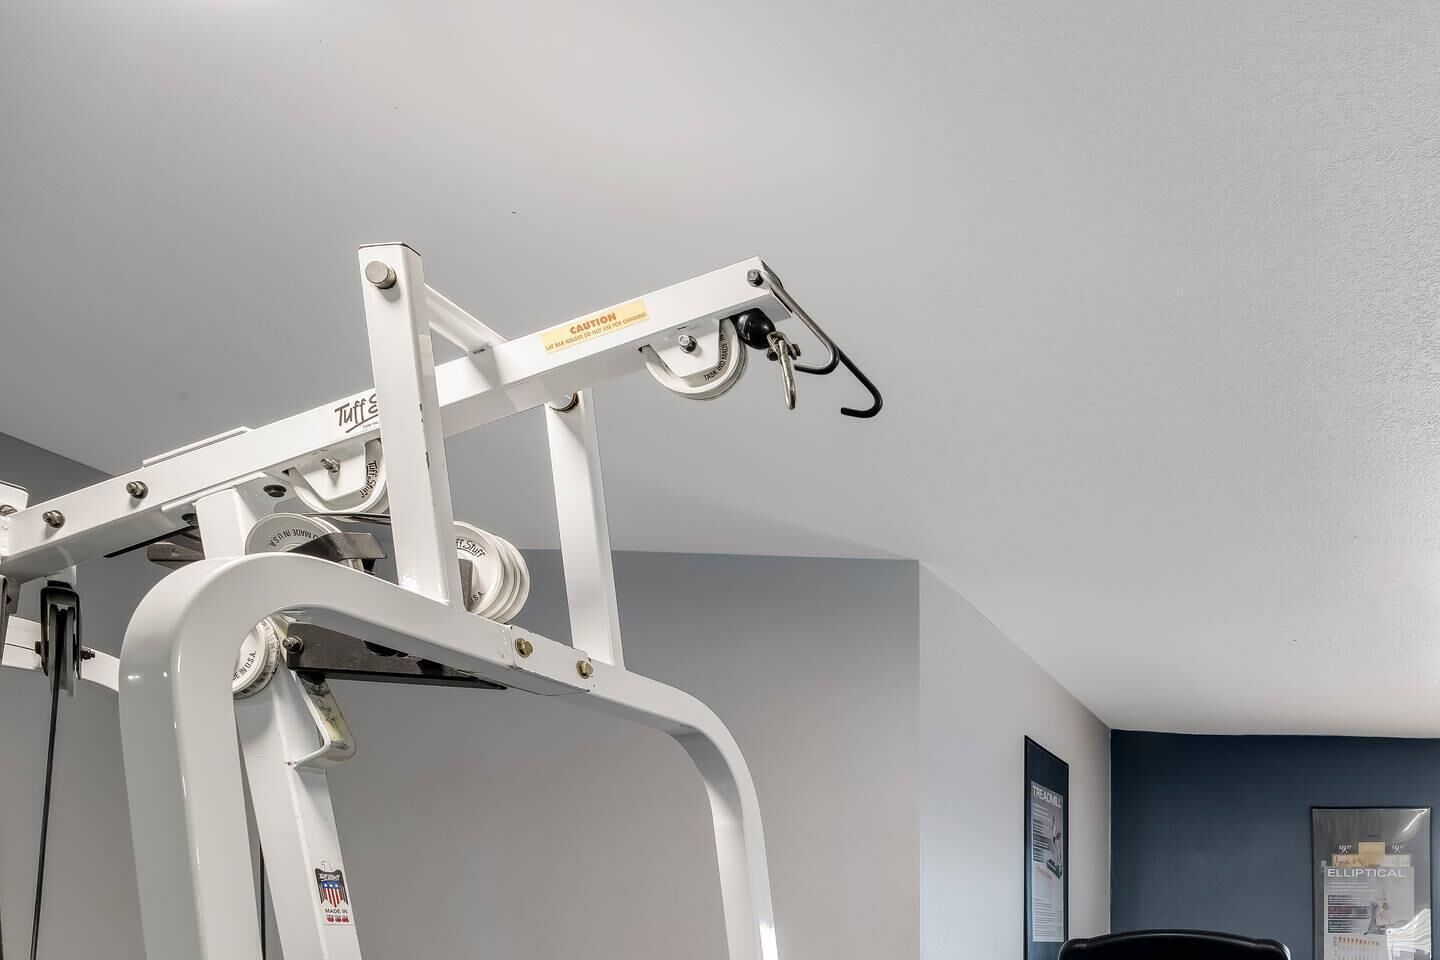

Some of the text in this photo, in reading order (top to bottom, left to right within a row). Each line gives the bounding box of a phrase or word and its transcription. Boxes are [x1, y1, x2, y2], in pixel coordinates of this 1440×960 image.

[569, 312, 617, 335] CAUTION
[564, 334, 583, 345] HOLDER
[583, 331, 592, 339] DO
[703, 369, 718, 381] TASK
[721, 342, 729, 360] MADE
[334, 398, 367, 427] Tuff
[283, 529, 292, 538] IN
[292, 528, 312, 539] MADE
[463, 540, 486, 558] Stuff
[239, 665, 248, 676] IN
[1032, 785, 1062, 809] TREADMILL
[1327, 868, 1409, 878] ELLIPTICAL
